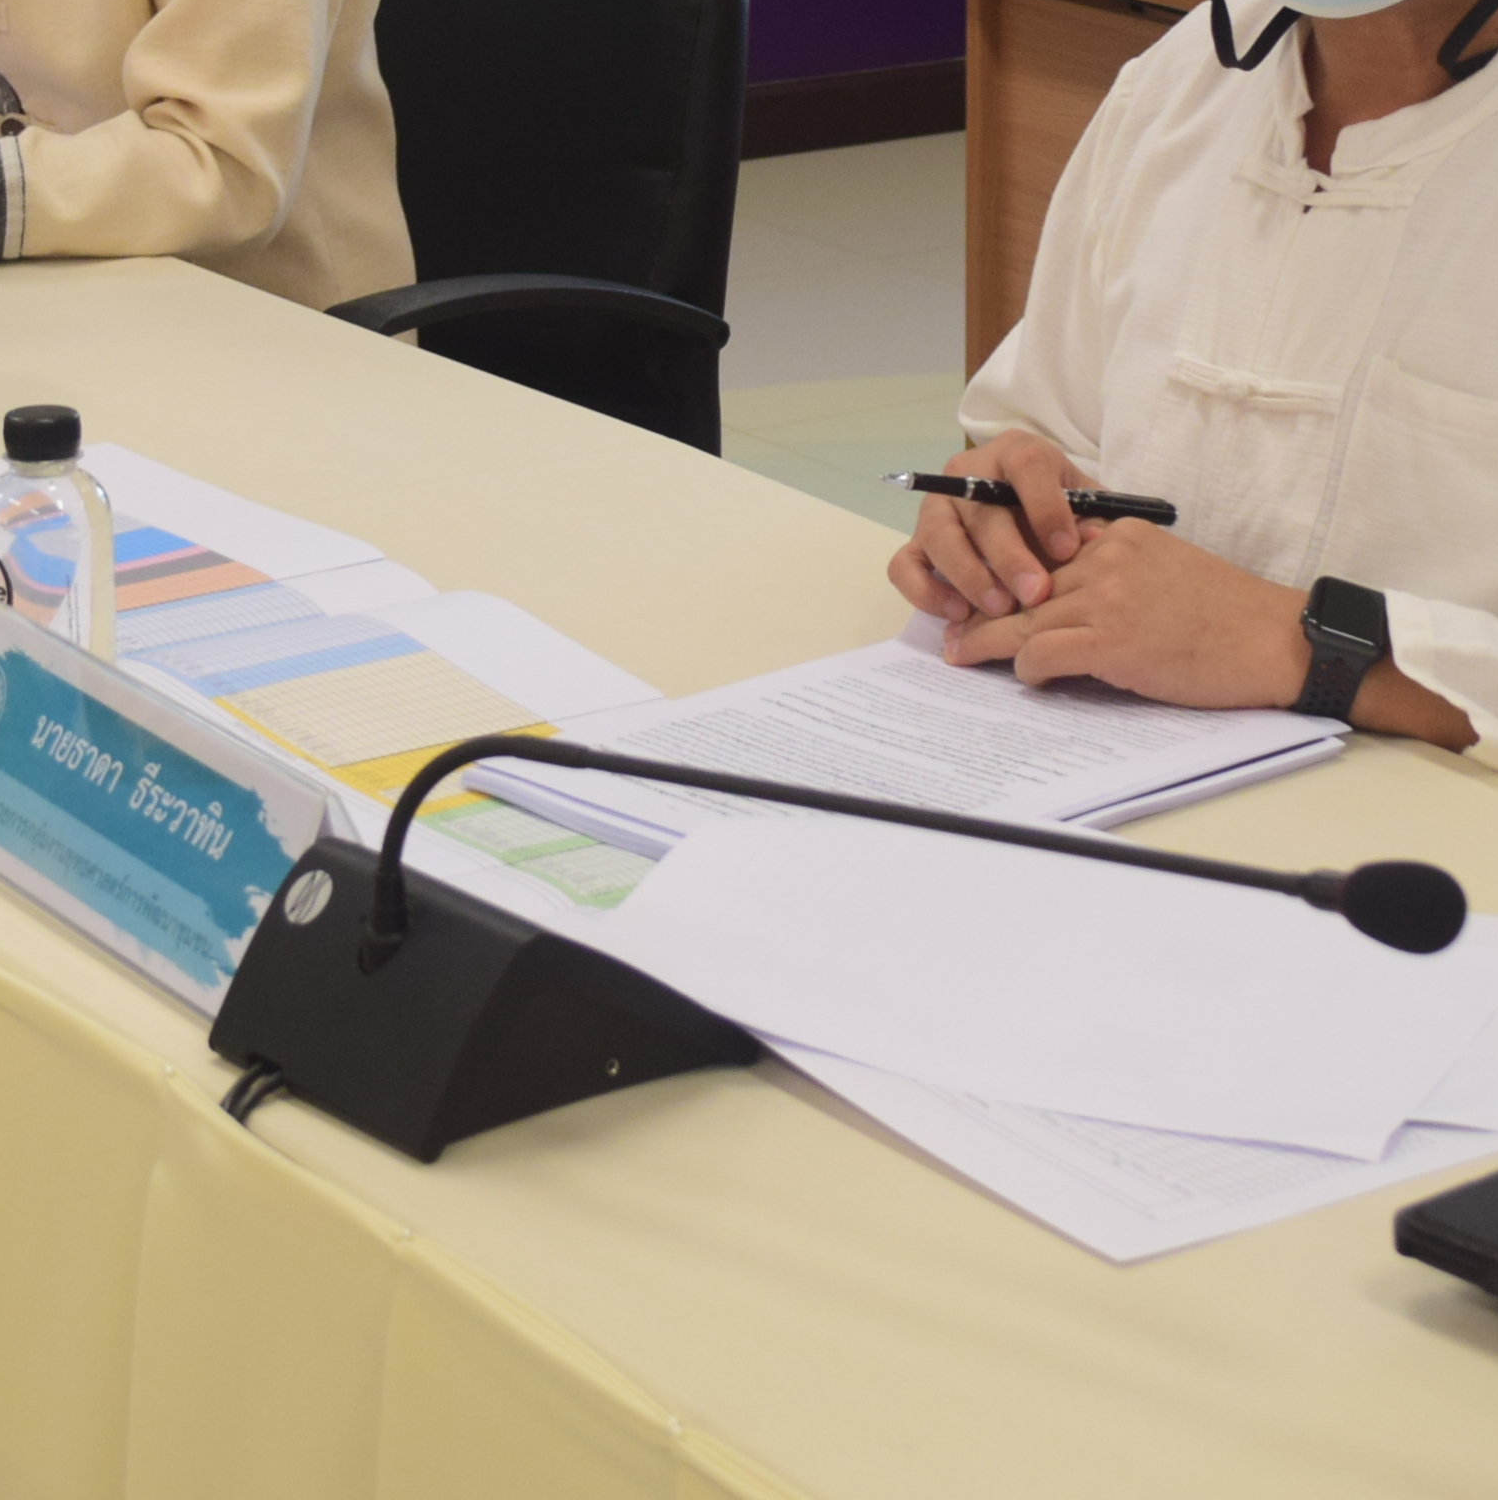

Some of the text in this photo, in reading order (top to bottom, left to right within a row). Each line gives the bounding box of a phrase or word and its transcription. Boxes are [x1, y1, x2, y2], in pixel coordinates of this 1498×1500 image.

[30, 714, 124, 794] นายธาดา
[128, 761, 234, 861] ธีระวาทิน
